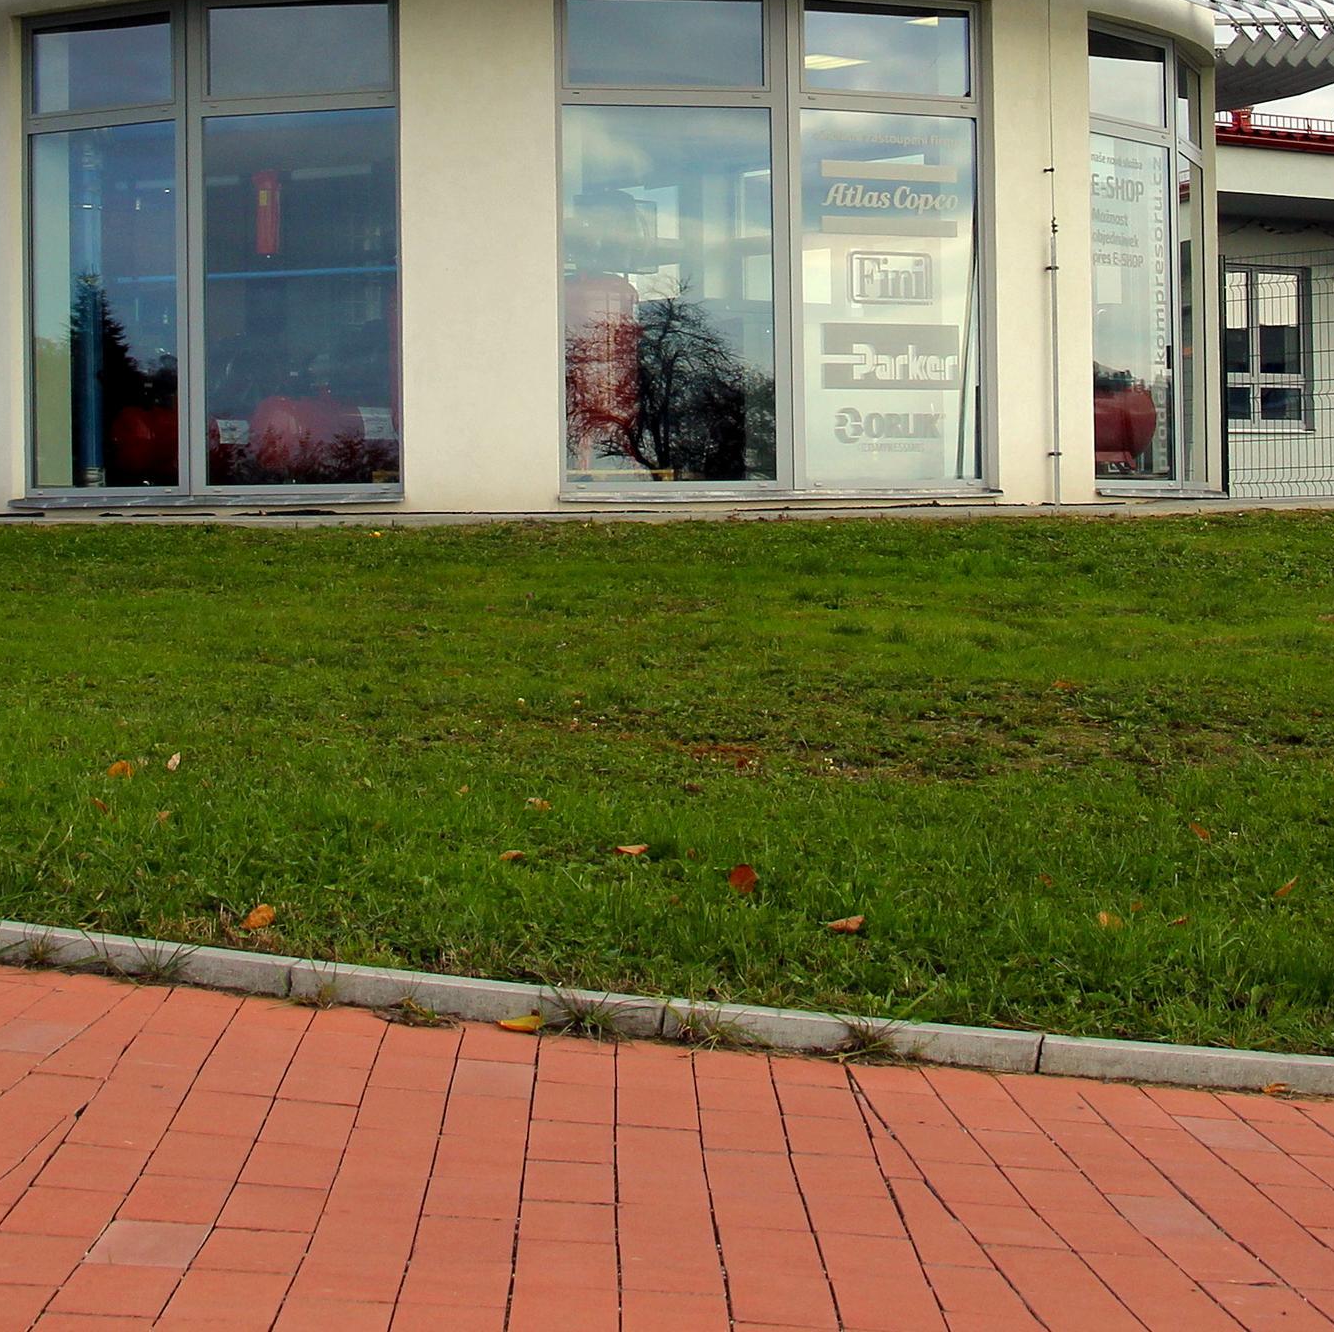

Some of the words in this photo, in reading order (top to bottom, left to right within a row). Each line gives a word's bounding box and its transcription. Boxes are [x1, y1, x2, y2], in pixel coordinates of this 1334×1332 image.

[821, 183, 891, 209] Atlas
[893, 185, 958, 214] Copco
[1091, 173, 1144, 202] E-SHOP
[1113, 251, 1144, 268] E-SHOP
[855, 256, 925, 299] Fini
[853, 343, 959, 381] Parker
